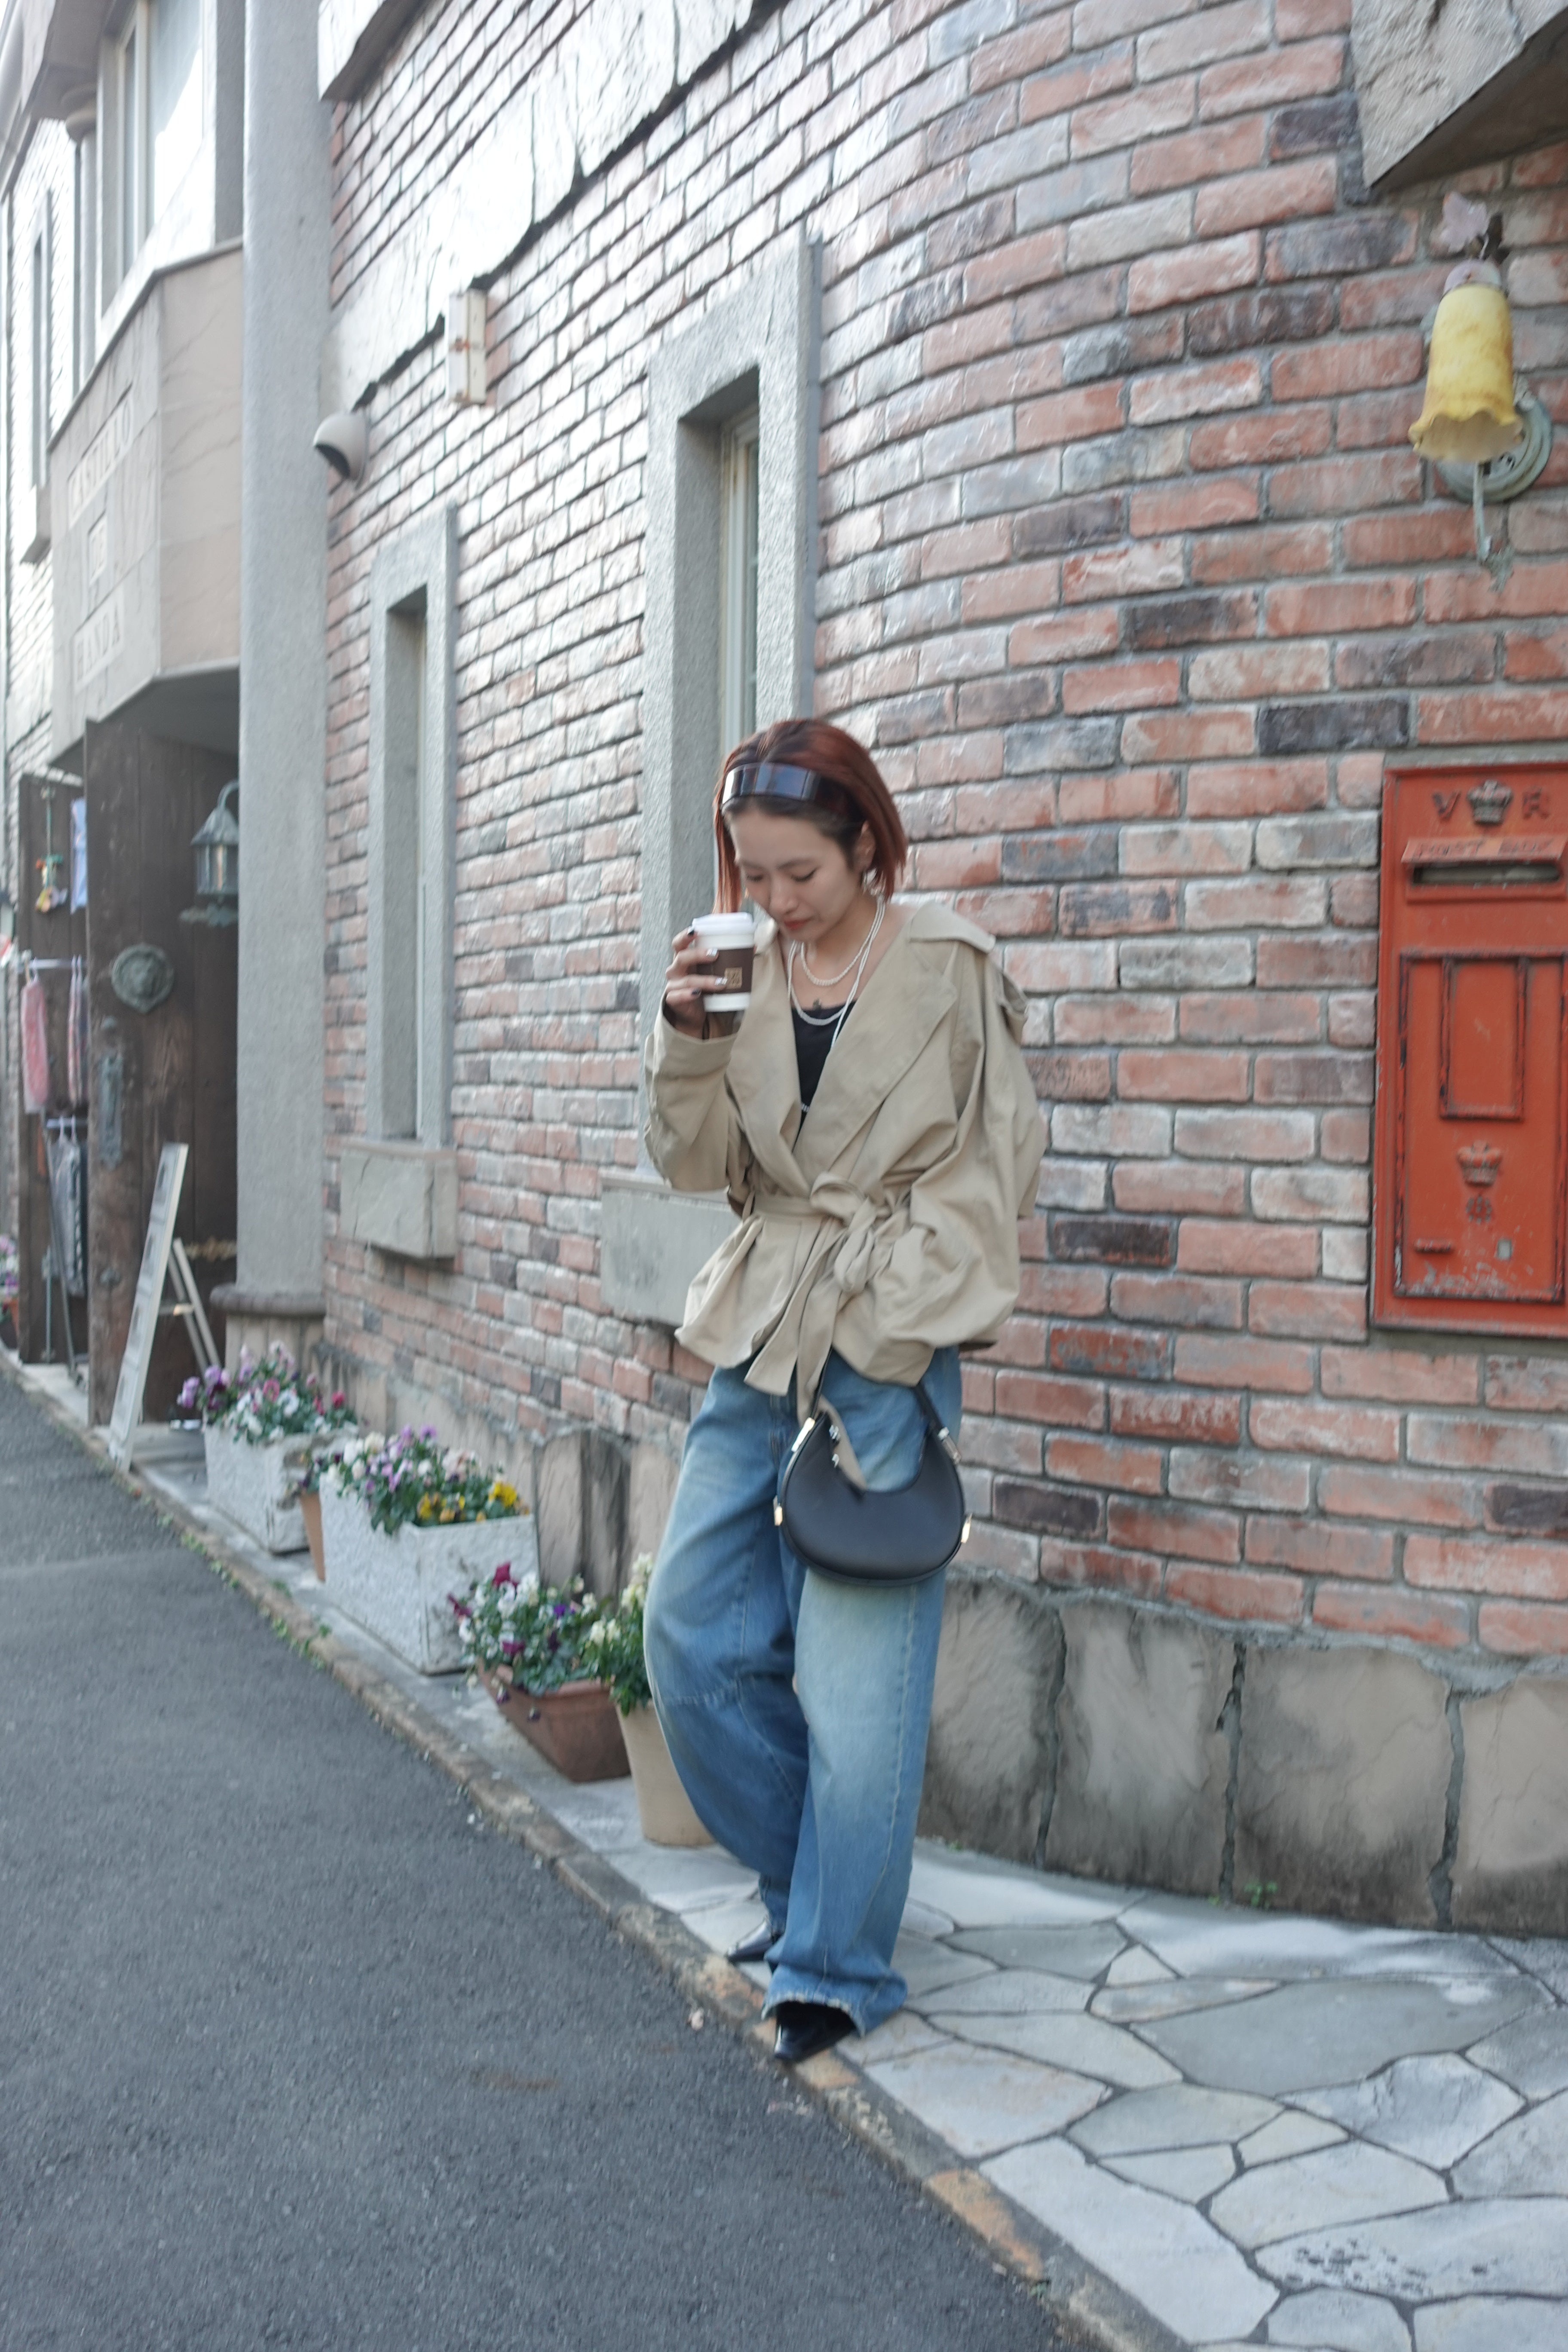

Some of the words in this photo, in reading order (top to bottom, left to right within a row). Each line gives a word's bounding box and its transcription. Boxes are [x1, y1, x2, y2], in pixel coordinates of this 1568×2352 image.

[70, 398, 131, 518] CASTILLO
[1432, 791, 1461, 821] V
[1522, 786, 1550, 819] R
